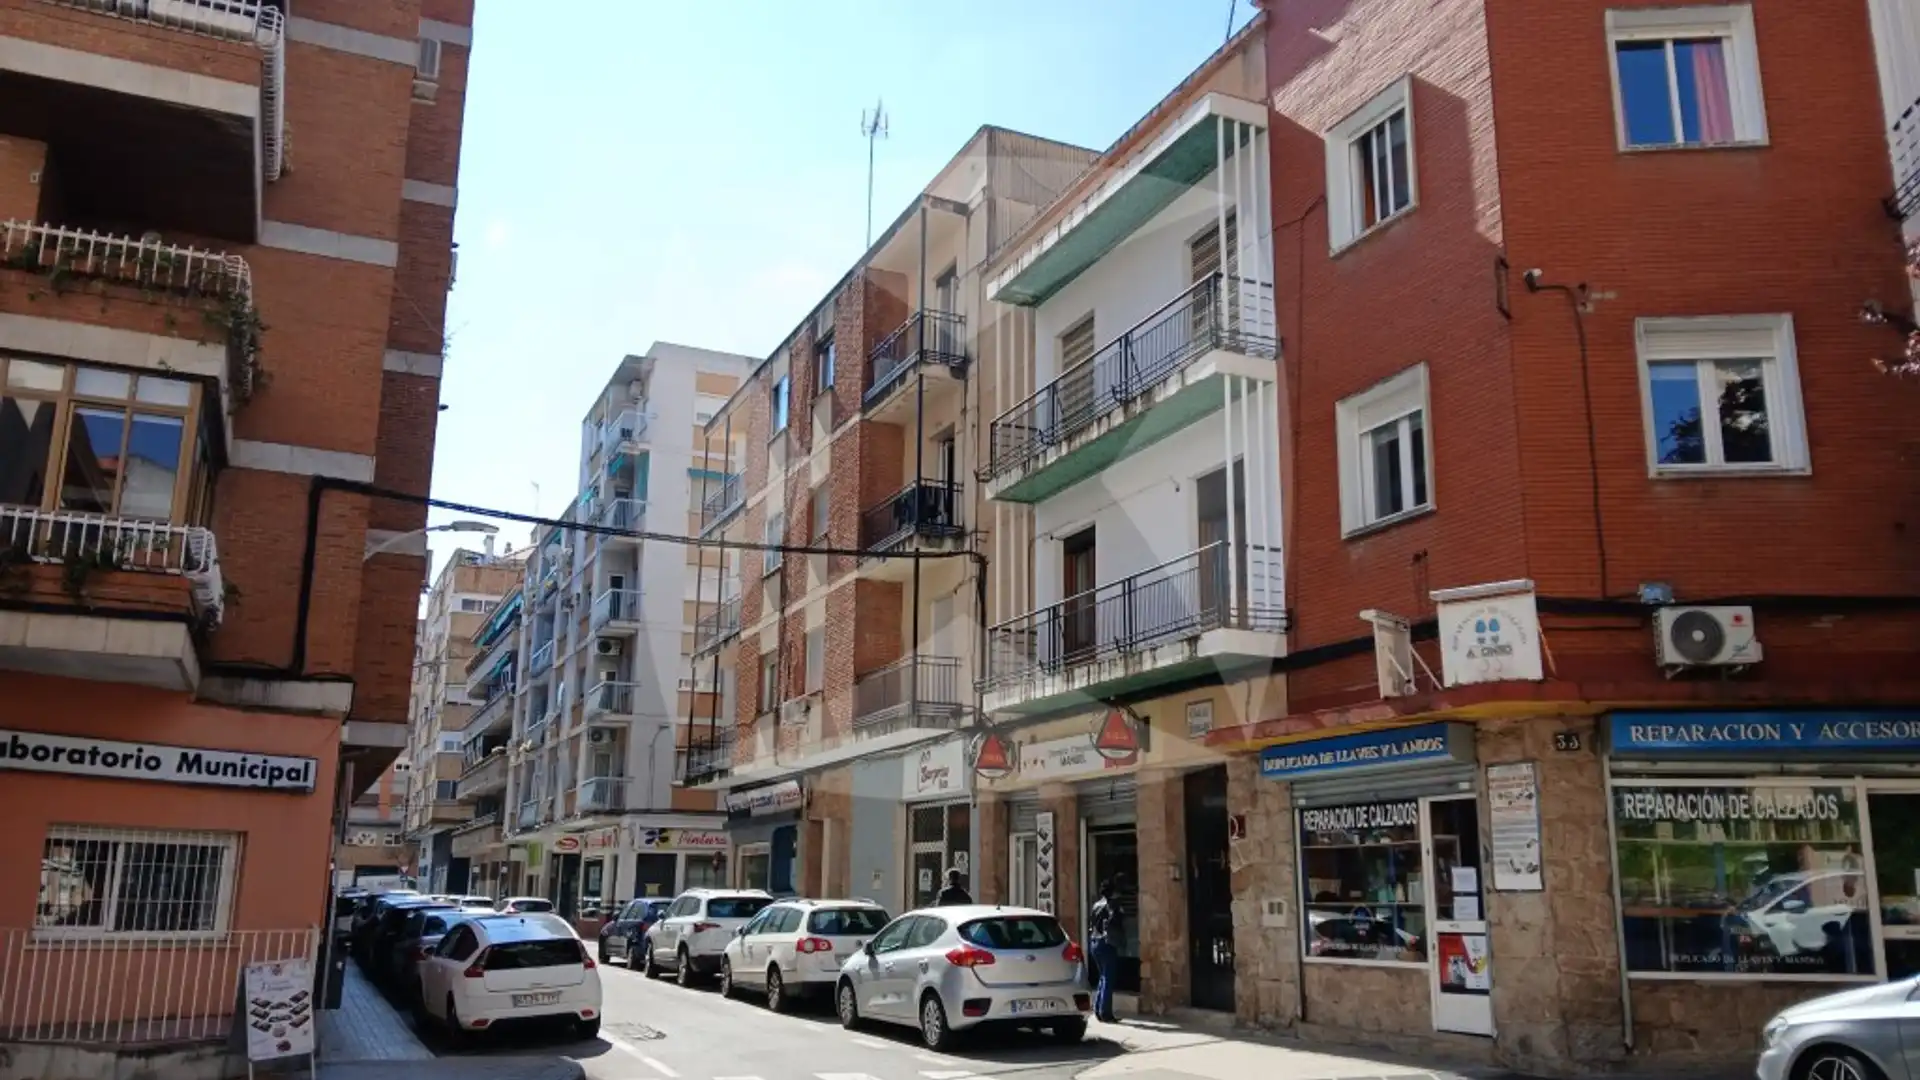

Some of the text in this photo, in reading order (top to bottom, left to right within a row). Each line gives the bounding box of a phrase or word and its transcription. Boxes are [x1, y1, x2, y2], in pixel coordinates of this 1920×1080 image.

[1629, 723, 1781, 742] REPARACION
[1789, 723, 1804, 740] Y
[176, 751, 310, 785] Municipal
[1320, 751, 1334, 765] DE
[1355, 806, 1369, 828] DE
[1369, 802, 1417, 827] CALZADOS
[1624, 789, 1839, 820] REPARACIÓN DE CALZADOS
